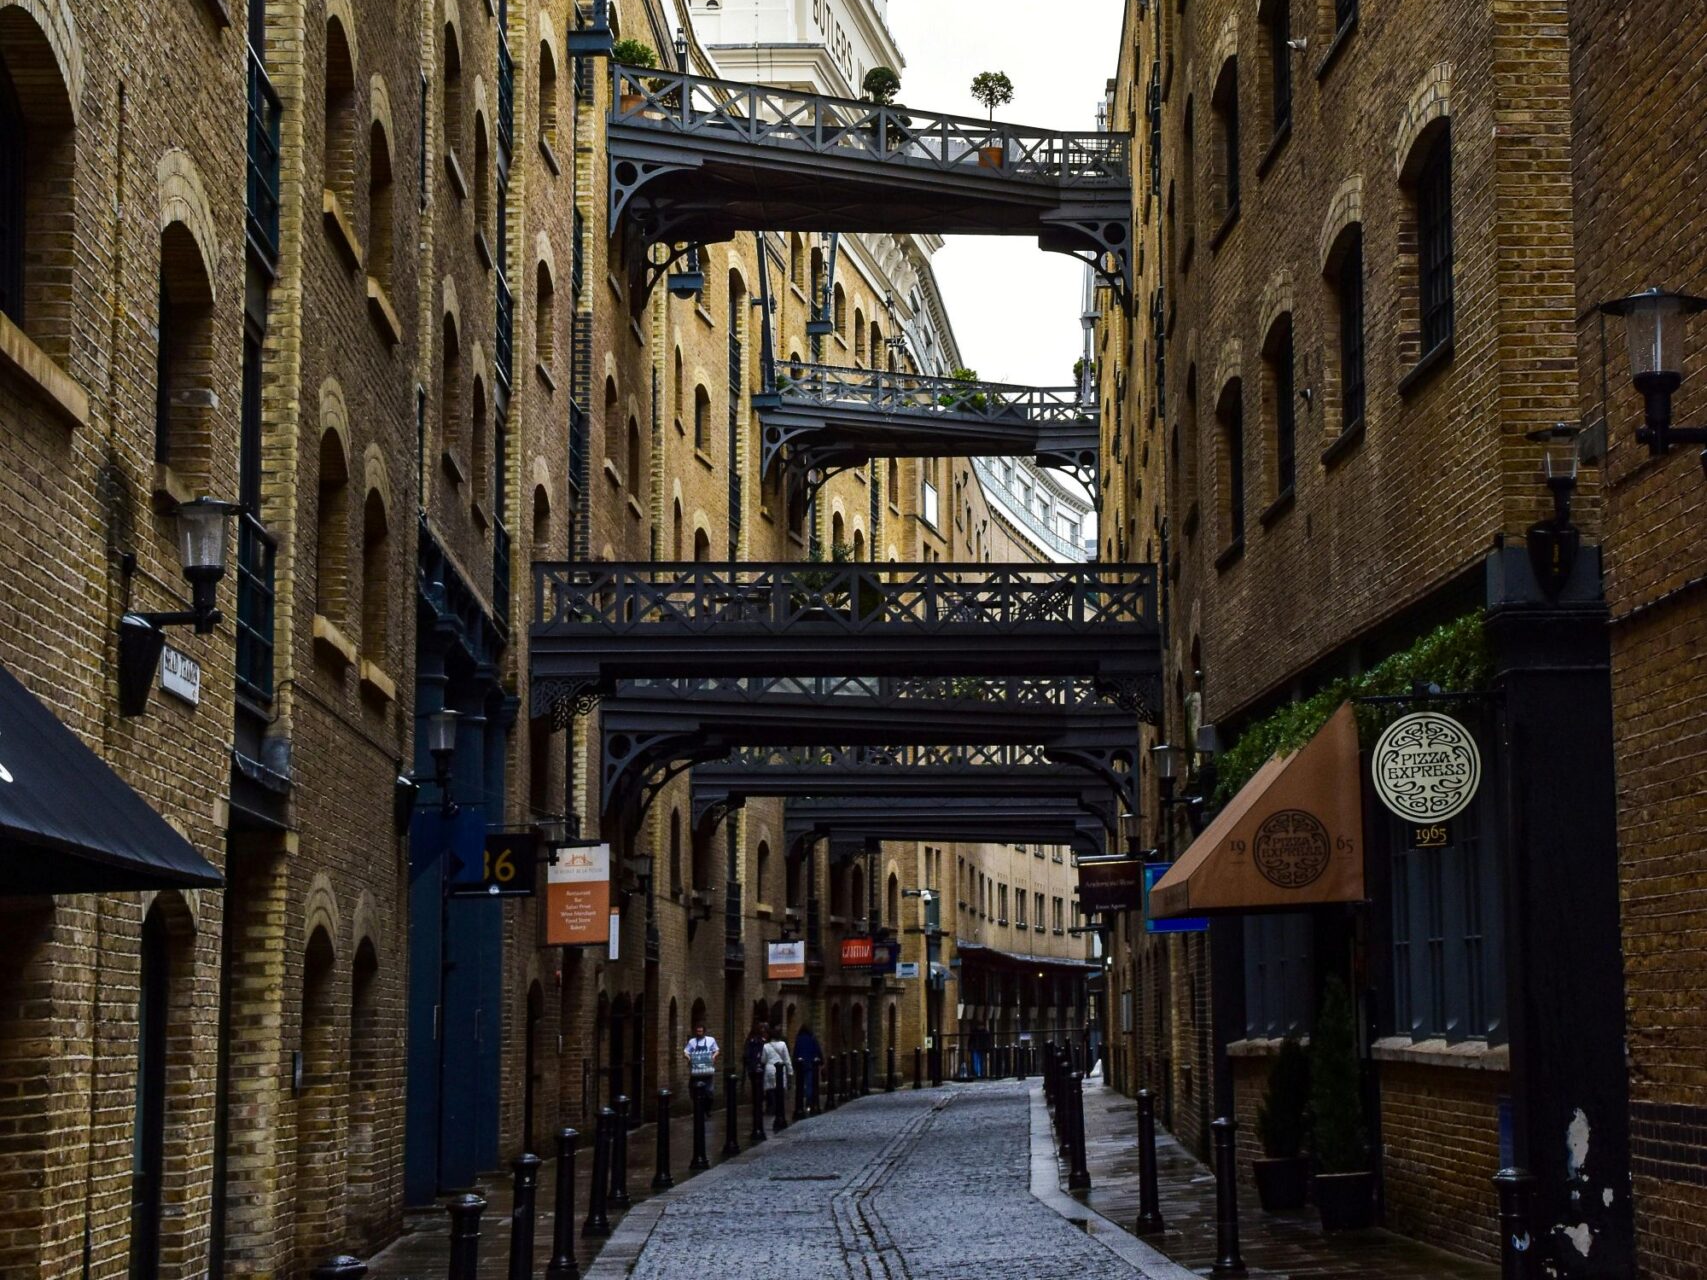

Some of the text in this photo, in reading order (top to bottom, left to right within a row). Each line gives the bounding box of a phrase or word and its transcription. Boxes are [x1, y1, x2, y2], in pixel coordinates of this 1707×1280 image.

[1402, 751, 1451, 765] PIZZA
[1387, 763, 1466, 779] EXPRESS
[1416, 824, 1447, 844] 1965
[1230, 835, 1354, 855] 19 65
[1272, 836, 1311, 848] PIZZA
[1261, 846, 1322, 858] EXPRESS
